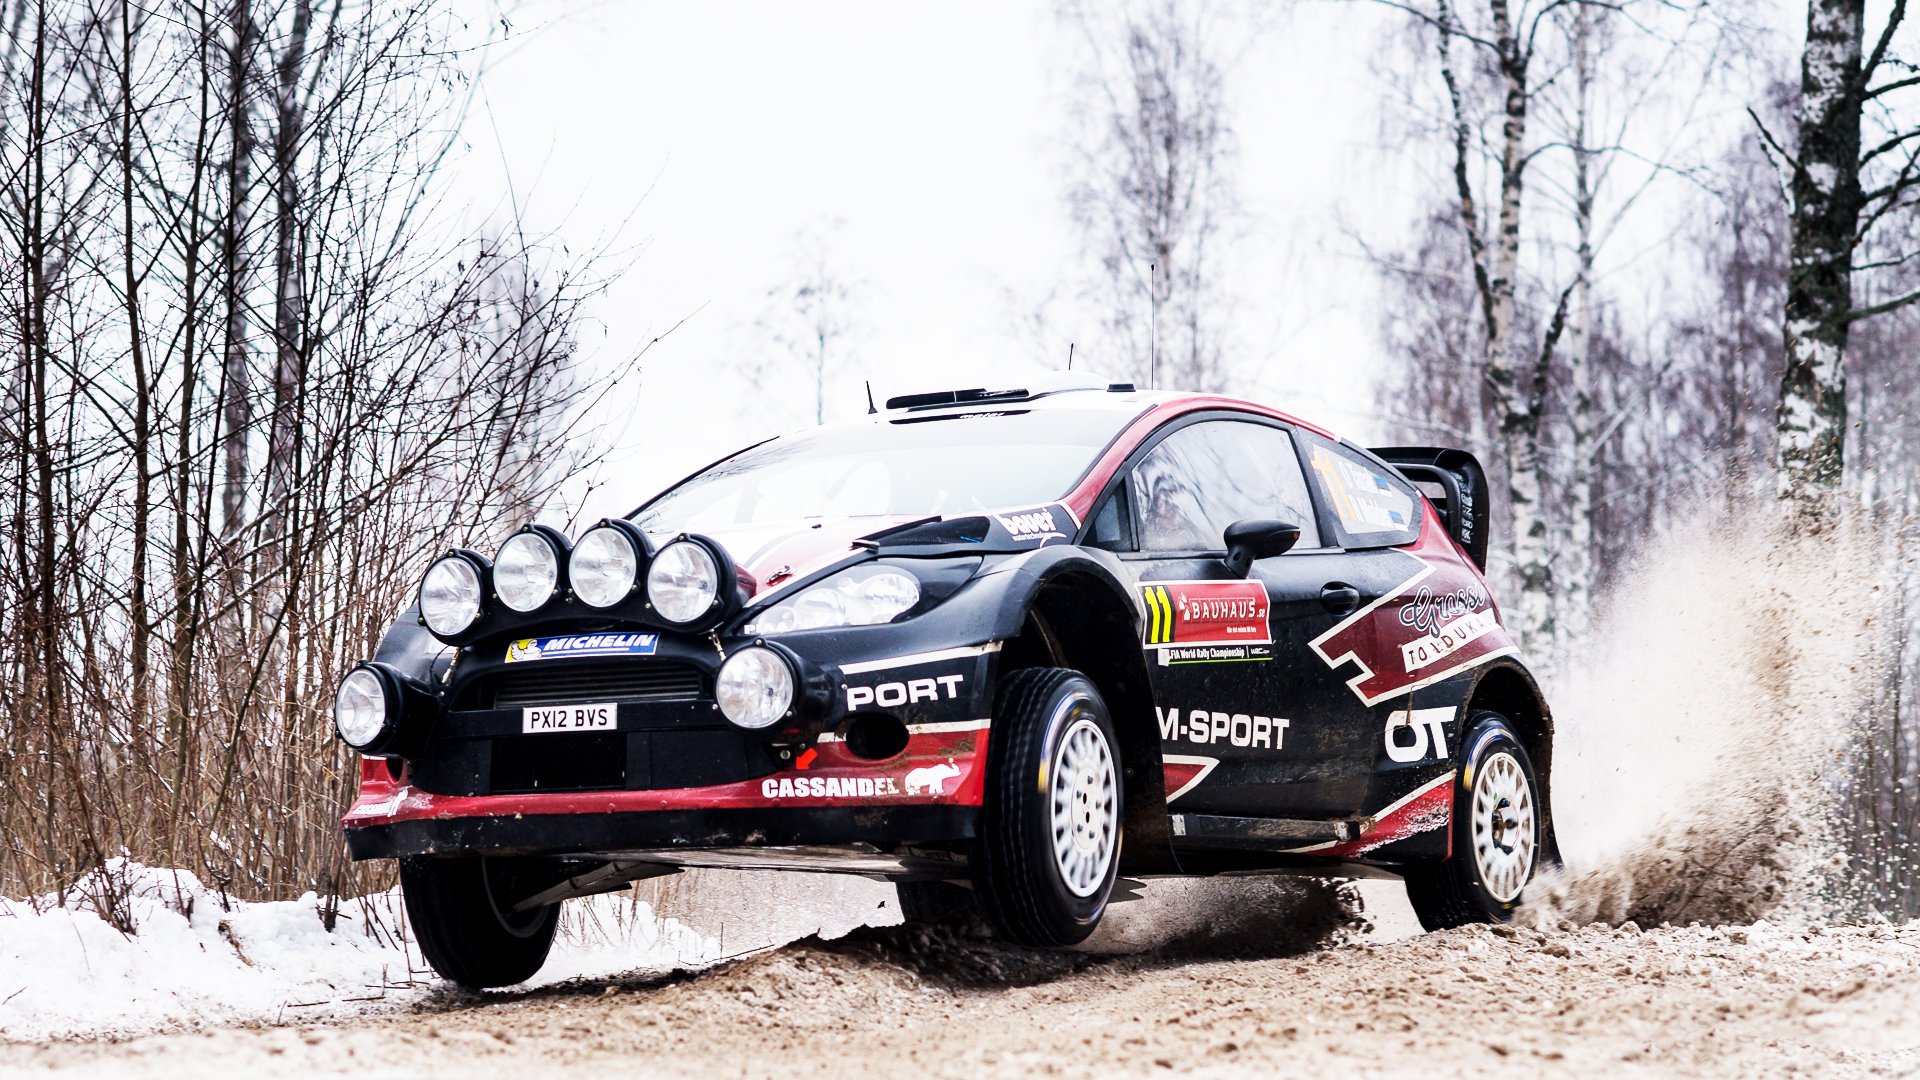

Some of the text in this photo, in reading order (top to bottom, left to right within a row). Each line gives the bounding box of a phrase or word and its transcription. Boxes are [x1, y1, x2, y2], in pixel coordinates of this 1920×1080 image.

[1144, 585, 1172, 643] 11
[544, 633, 655, 651] MICHELIN
[1181, 649, 1197, 660] World
[1197, 648, 1210, 660] Rally
[1210, 646, 1245, 660] Championship
[531, 708, 607, 729] PX12 BVS
[1155, 706, 1290, 750] M-SPORT
[1384, 705, 1458, 763] OT
[761, 777, 899, 798] CASSANDEL
